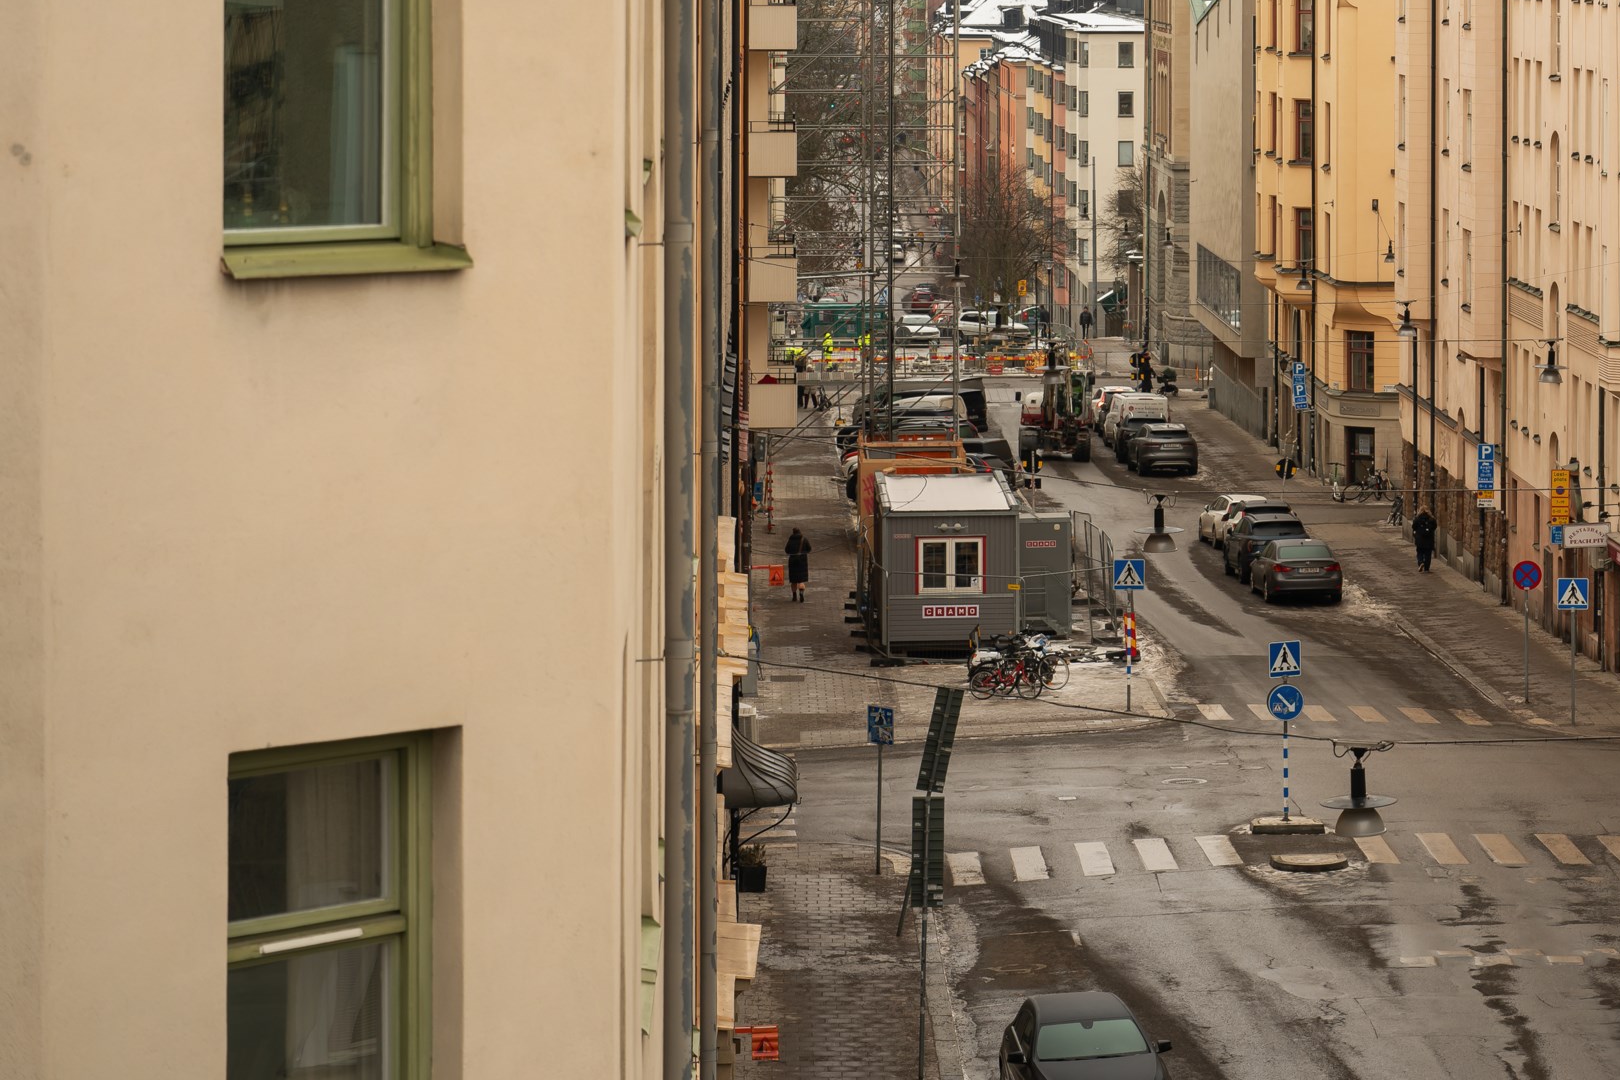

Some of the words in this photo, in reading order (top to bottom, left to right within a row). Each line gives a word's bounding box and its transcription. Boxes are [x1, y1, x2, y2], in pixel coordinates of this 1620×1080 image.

[1296, 363, 1303, 373] P
[1296, 385, 1303, 395] P
[1481, 445, 1491, 459] P
[926, 607, 976, 615] CRAMO
